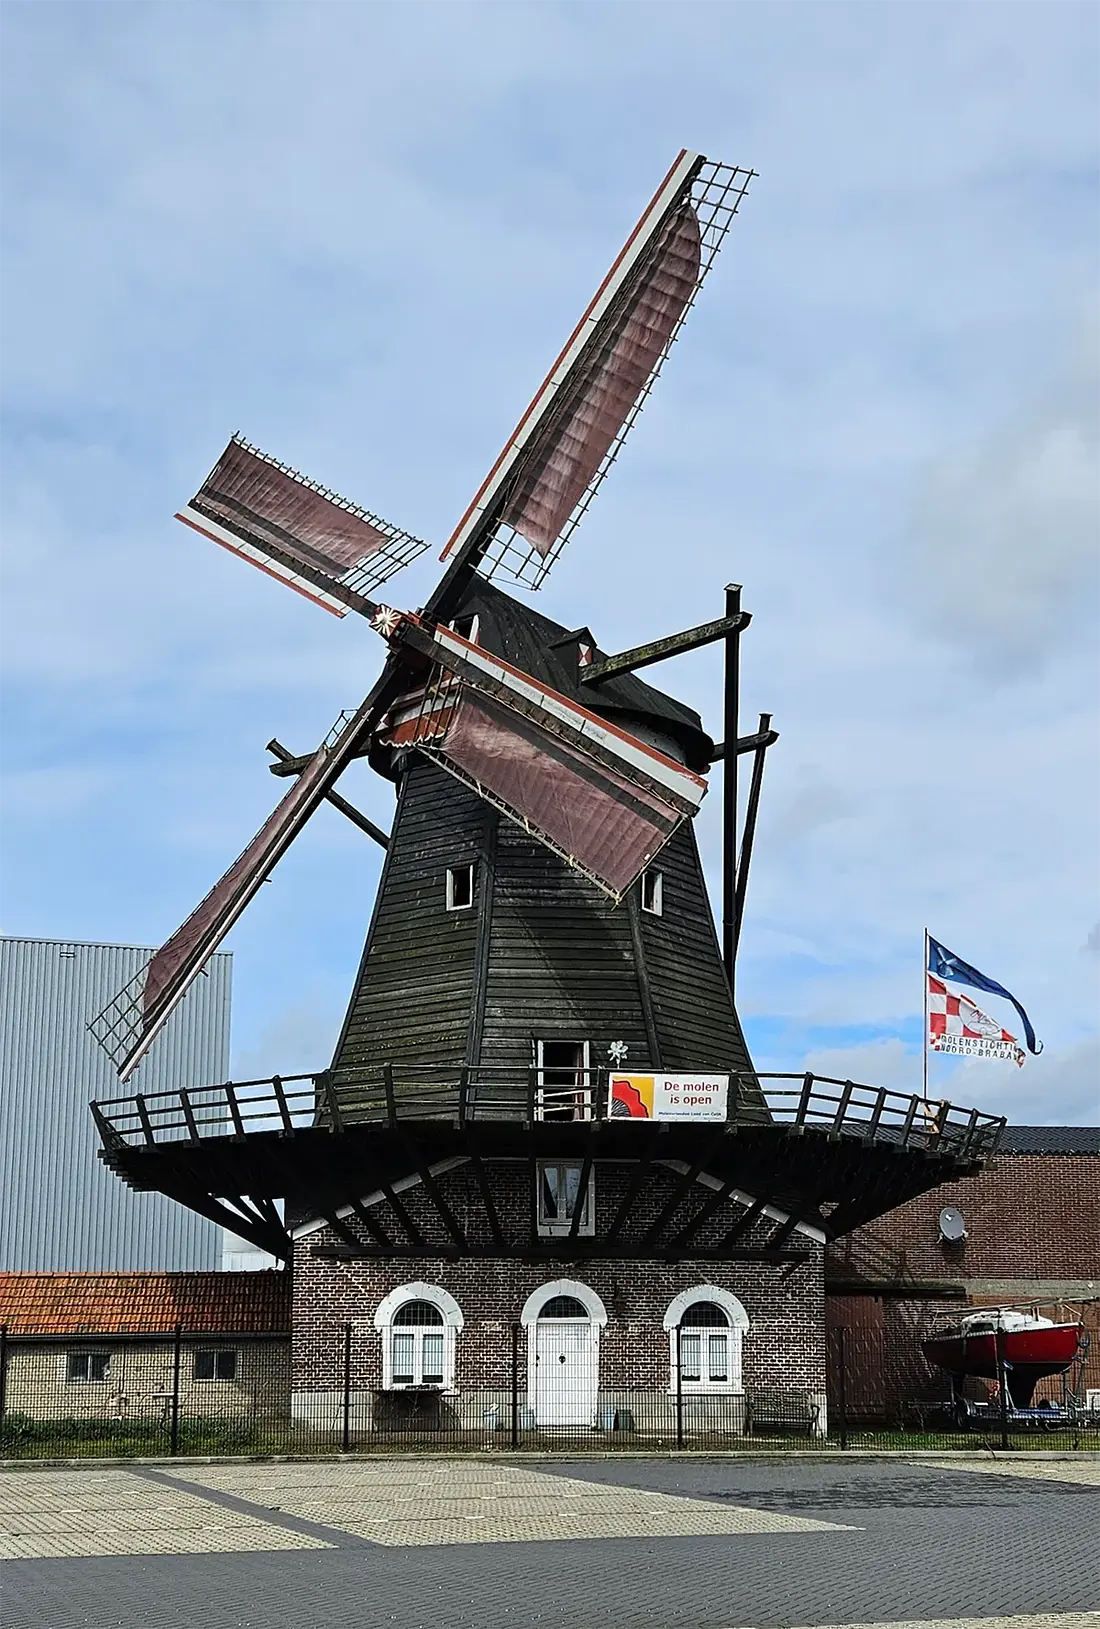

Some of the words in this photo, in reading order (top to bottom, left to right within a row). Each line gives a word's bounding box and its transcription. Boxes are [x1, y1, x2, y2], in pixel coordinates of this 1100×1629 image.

[664, 1081, 680, 1091] De
[683, 1081, 719, 1092] molen
[670, 1094, 680, 1104] is
[683, 1096, 712, 1106] open
